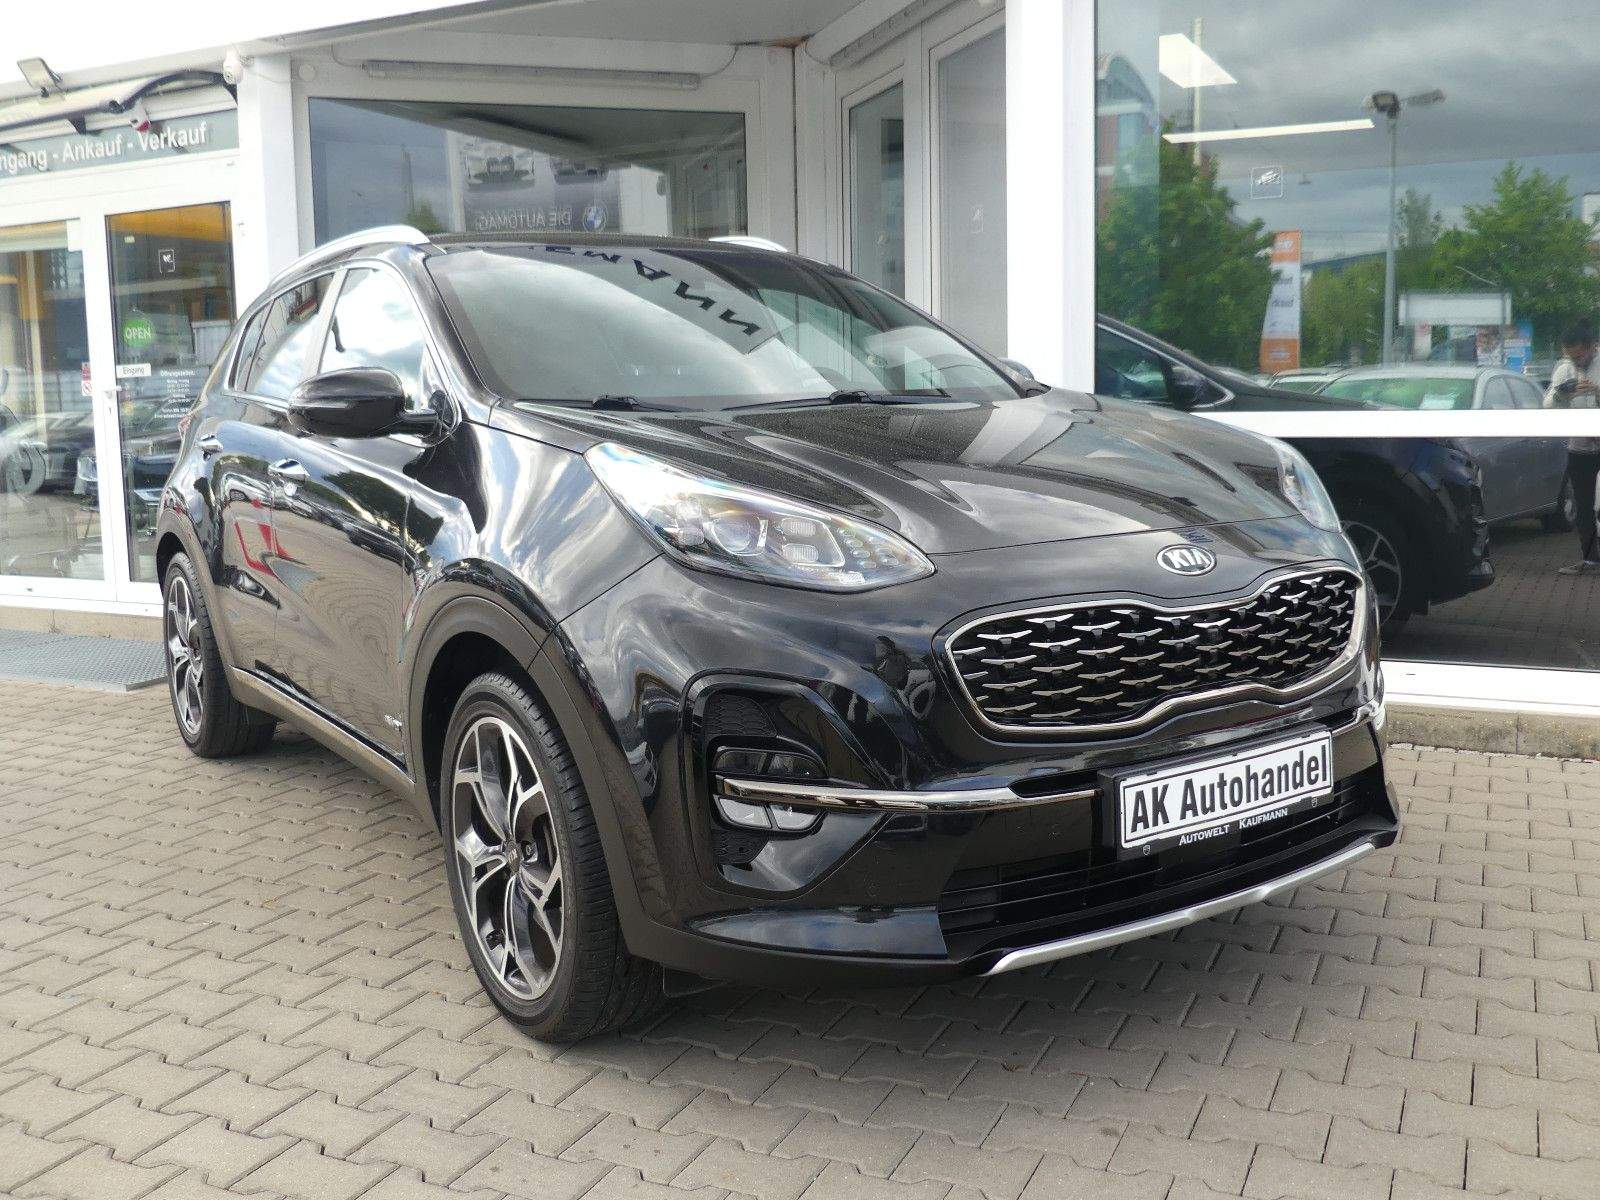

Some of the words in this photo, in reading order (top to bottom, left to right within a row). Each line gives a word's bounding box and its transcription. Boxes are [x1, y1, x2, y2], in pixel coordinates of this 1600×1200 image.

[62, 133, 123, 162] Ankauf
[137, 119, 208, 152] Verkauf
[124, 326, 152, 341] OPEN
[1164, 547, 1211, 569] KIA
[1130, 783, 1171, 834] AK
[1179, 744, 1328, 821] Autohandel
[1179, 824, 1230, 846] AUTOWELT
[1239, 807, 1288, 829] KAUFMANN
